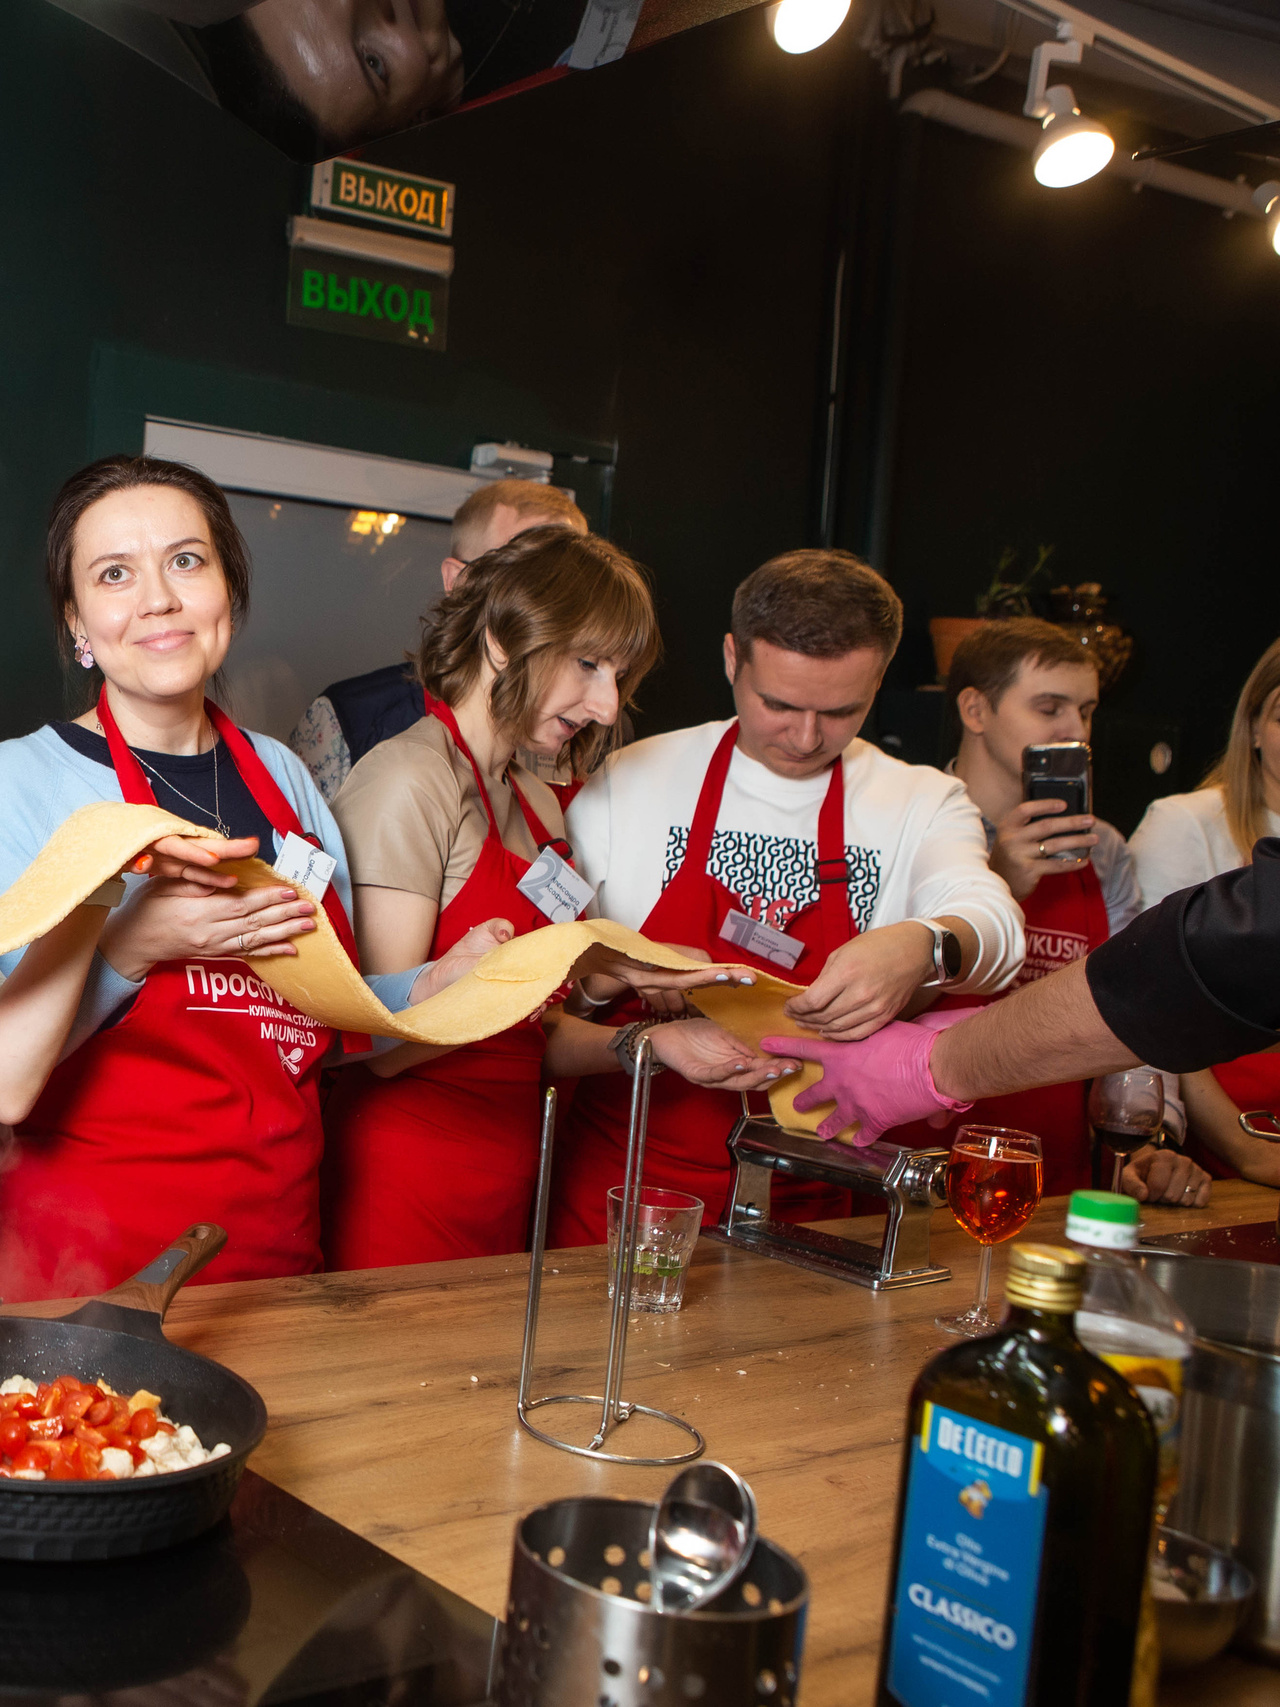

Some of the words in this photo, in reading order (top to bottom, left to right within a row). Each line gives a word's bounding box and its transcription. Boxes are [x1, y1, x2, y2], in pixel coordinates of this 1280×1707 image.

[339, 171, 435, 224] ВЫХОД
[303, 269, 435, 333] ВЫХОД
[260, 1021, 316, 1047] MAUNFELD
[292, 1014, 328, 1029] СТУД
[908, 1582, 1018, 1651] CLASSICO
